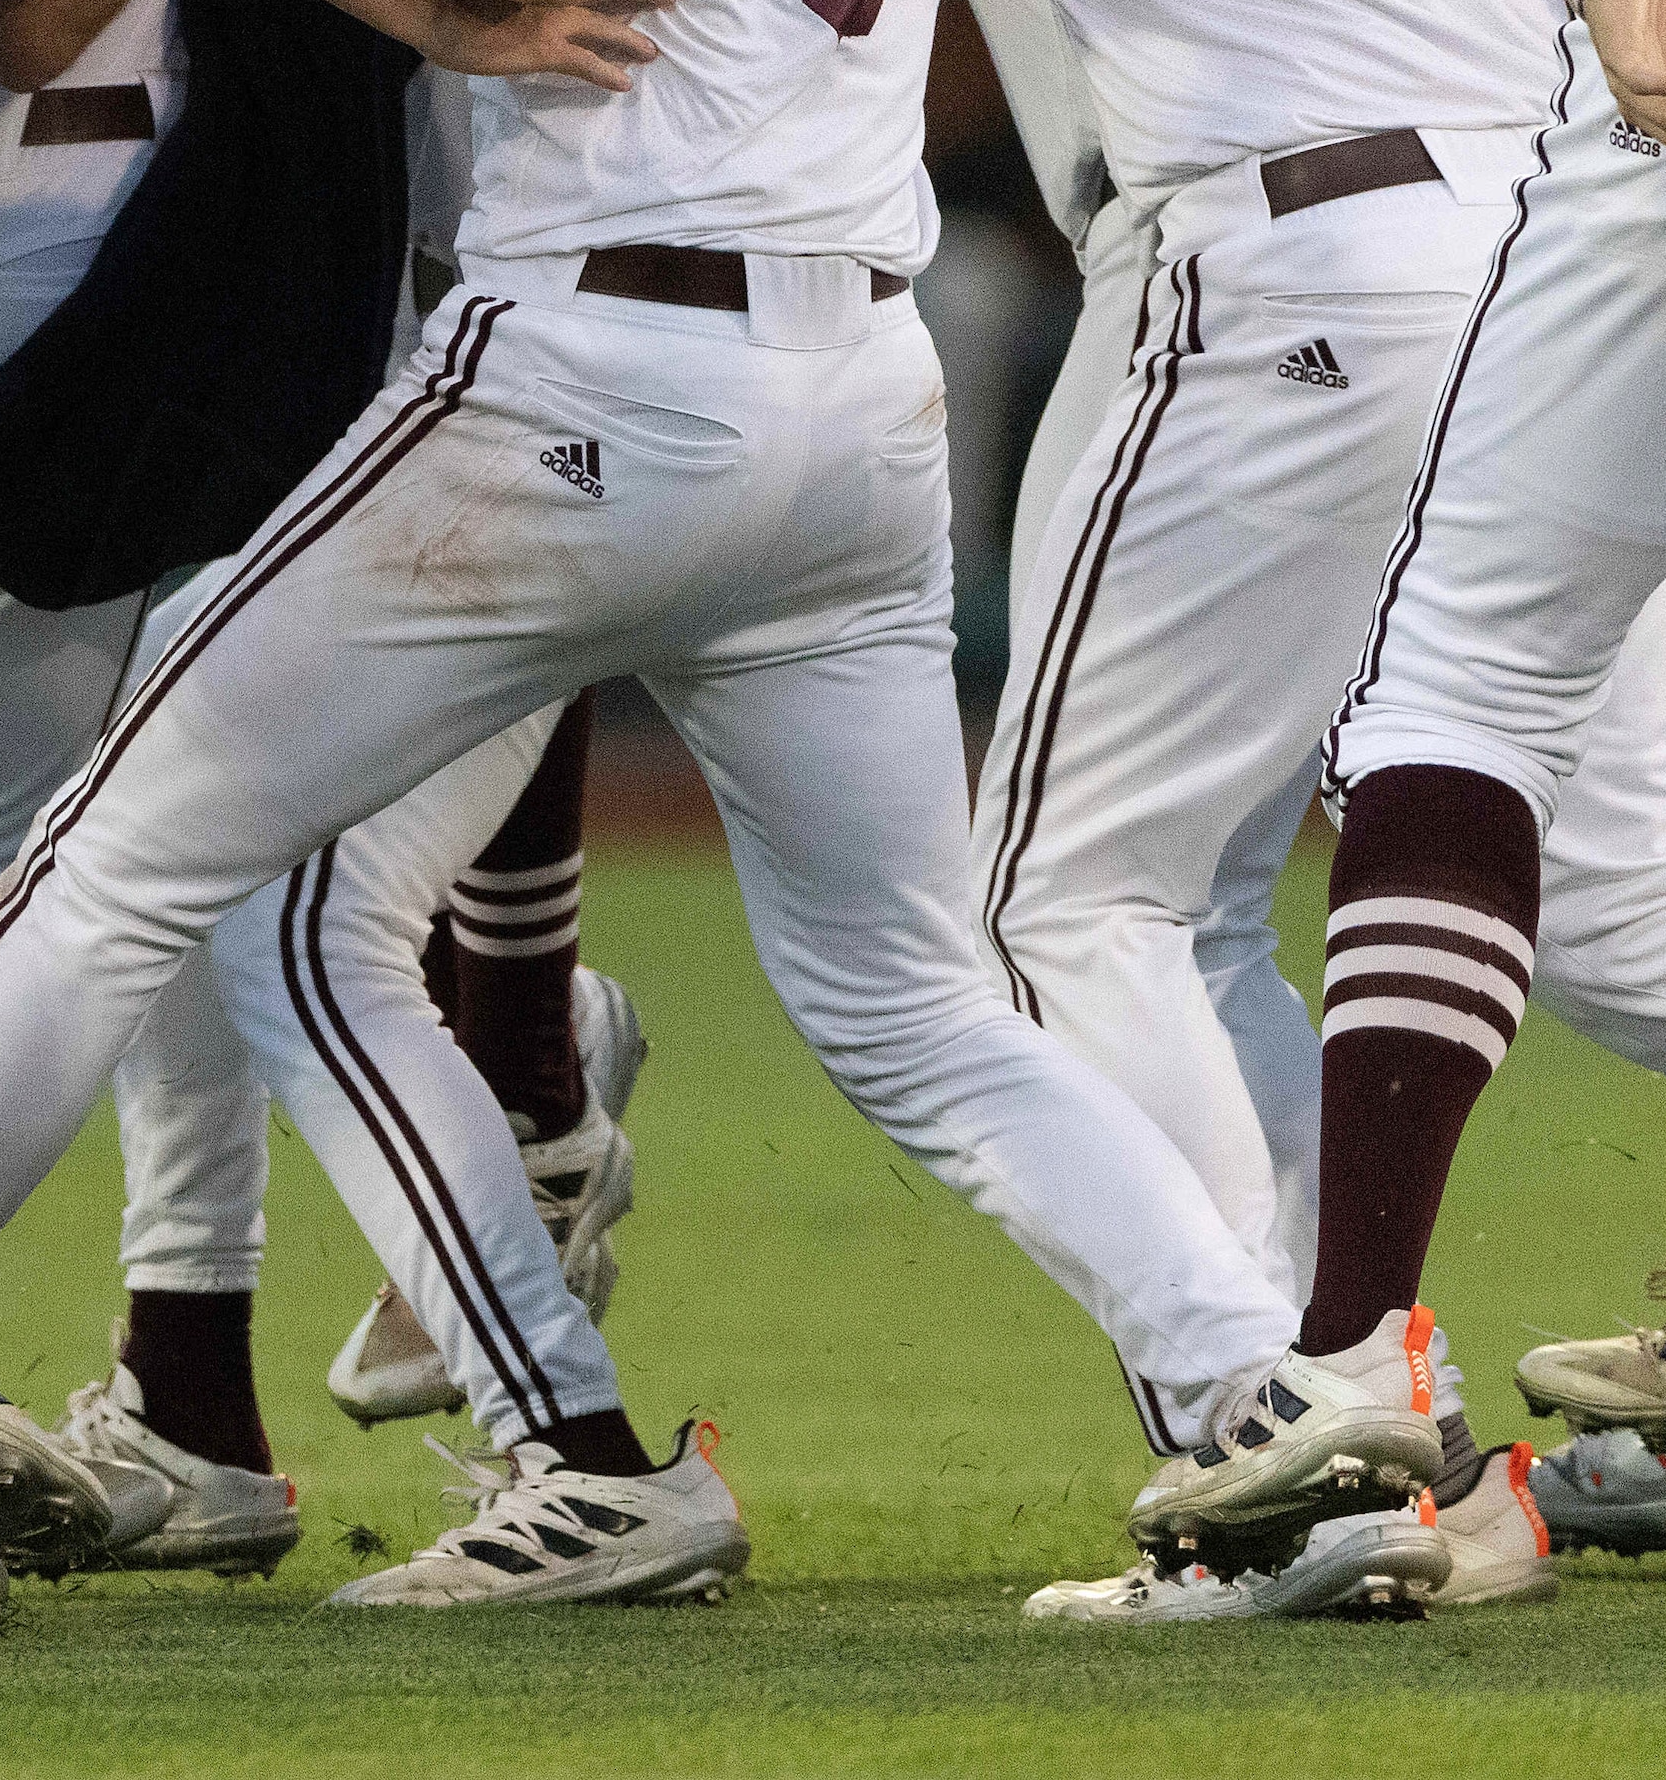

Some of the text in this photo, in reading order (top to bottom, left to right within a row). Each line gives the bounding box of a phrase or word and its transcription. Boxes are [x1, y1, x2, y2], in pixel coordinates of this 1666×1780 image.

[1609, 129, 1662, 158] adidas
[1277, 362, 1350, 390] adidas
[539, 450, 606, 499] adidas
